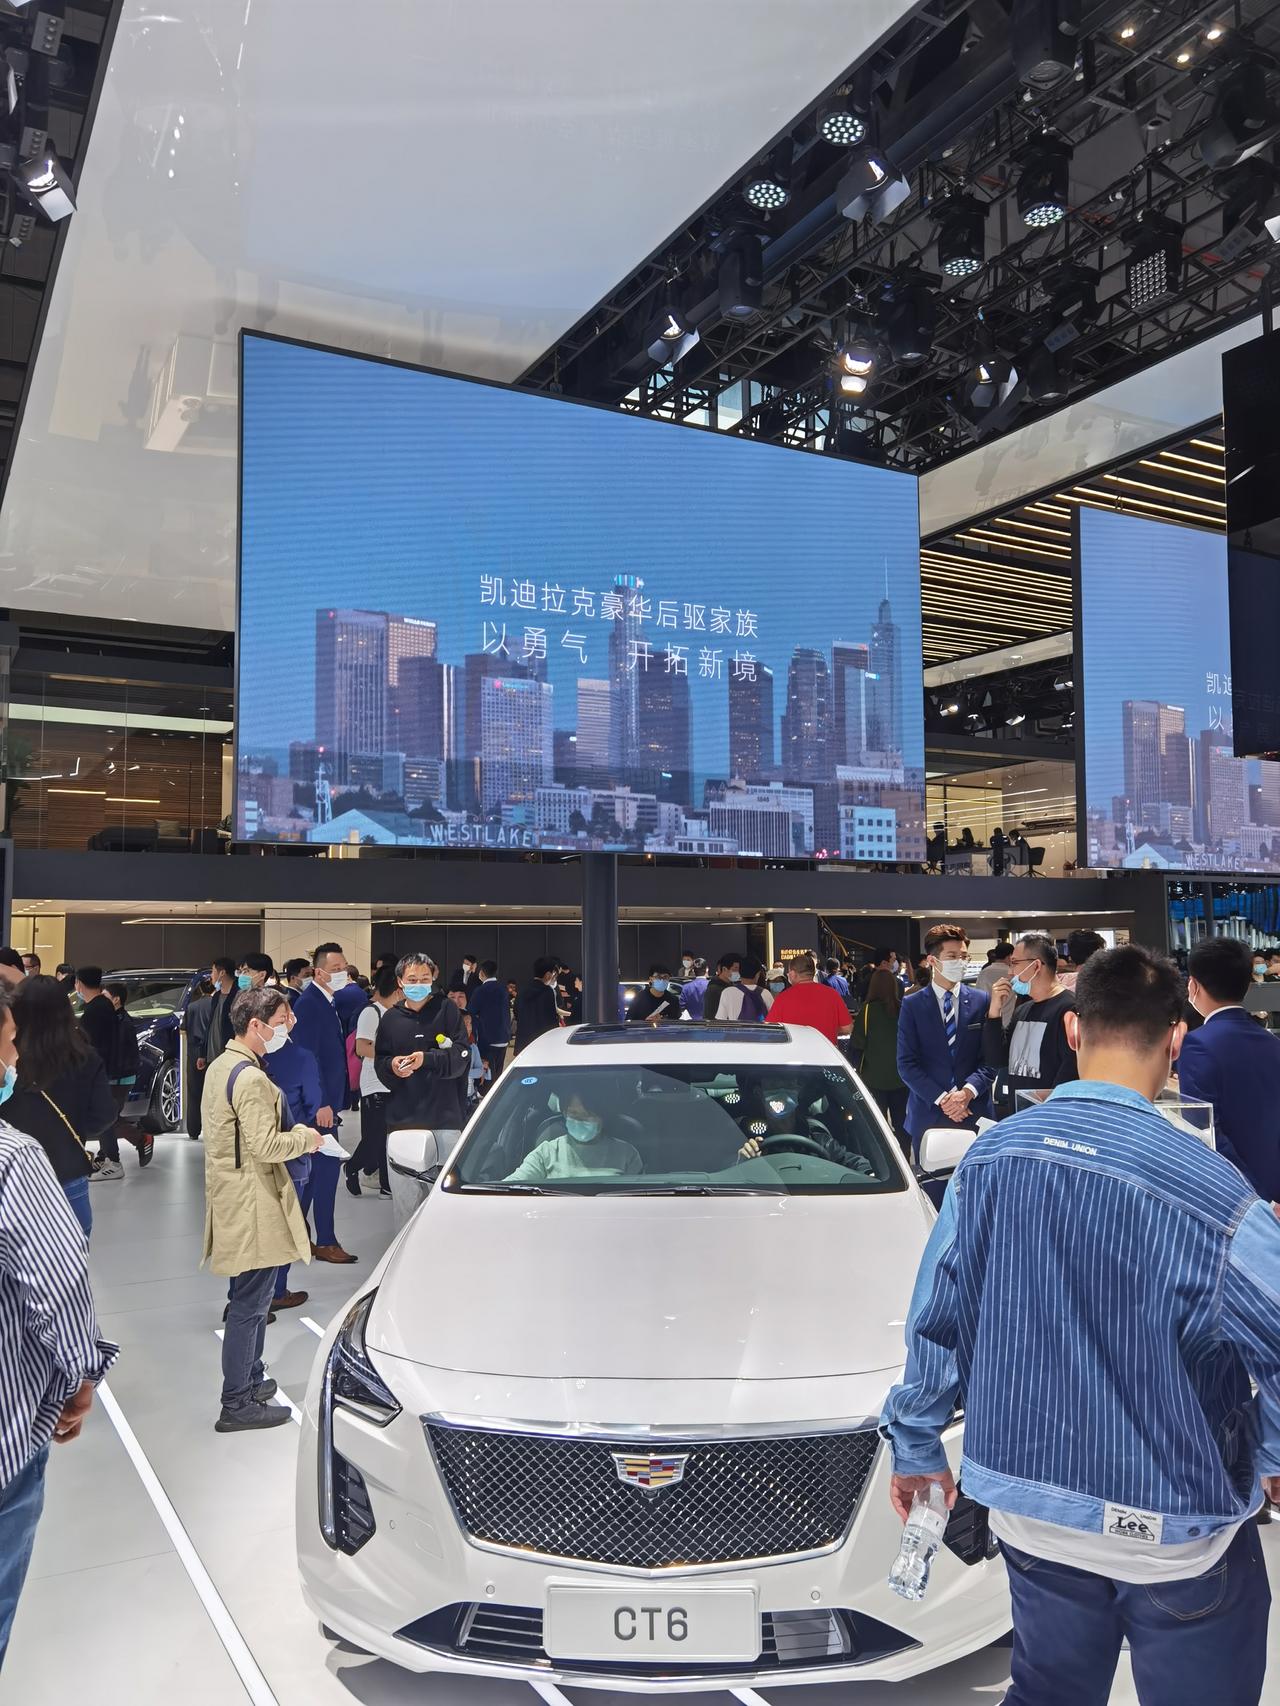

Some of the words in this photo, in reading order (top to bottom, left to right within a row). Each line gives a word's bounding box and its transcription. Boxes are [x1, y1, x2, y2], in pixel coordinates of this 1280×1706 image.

[479, 573, 758, 639] 凯迪拉克豪华后驱家族
[482, 621, 588, 664] 以勇气
[628, 639, 758, 682] 开拓新境
[1209, 705, 1233, 732] 以
[430, 823, 533, 847] WESTLAKE
[1184, 853, 1242, 871] WESTLAKE
[1043, 1136, 1069, 1149] DENIM
[1071, 1142, 1098, 1156] UNION
[1116, 1516, 1149, 1533] Lee
[613, 1606, 688, 1642] CT6
